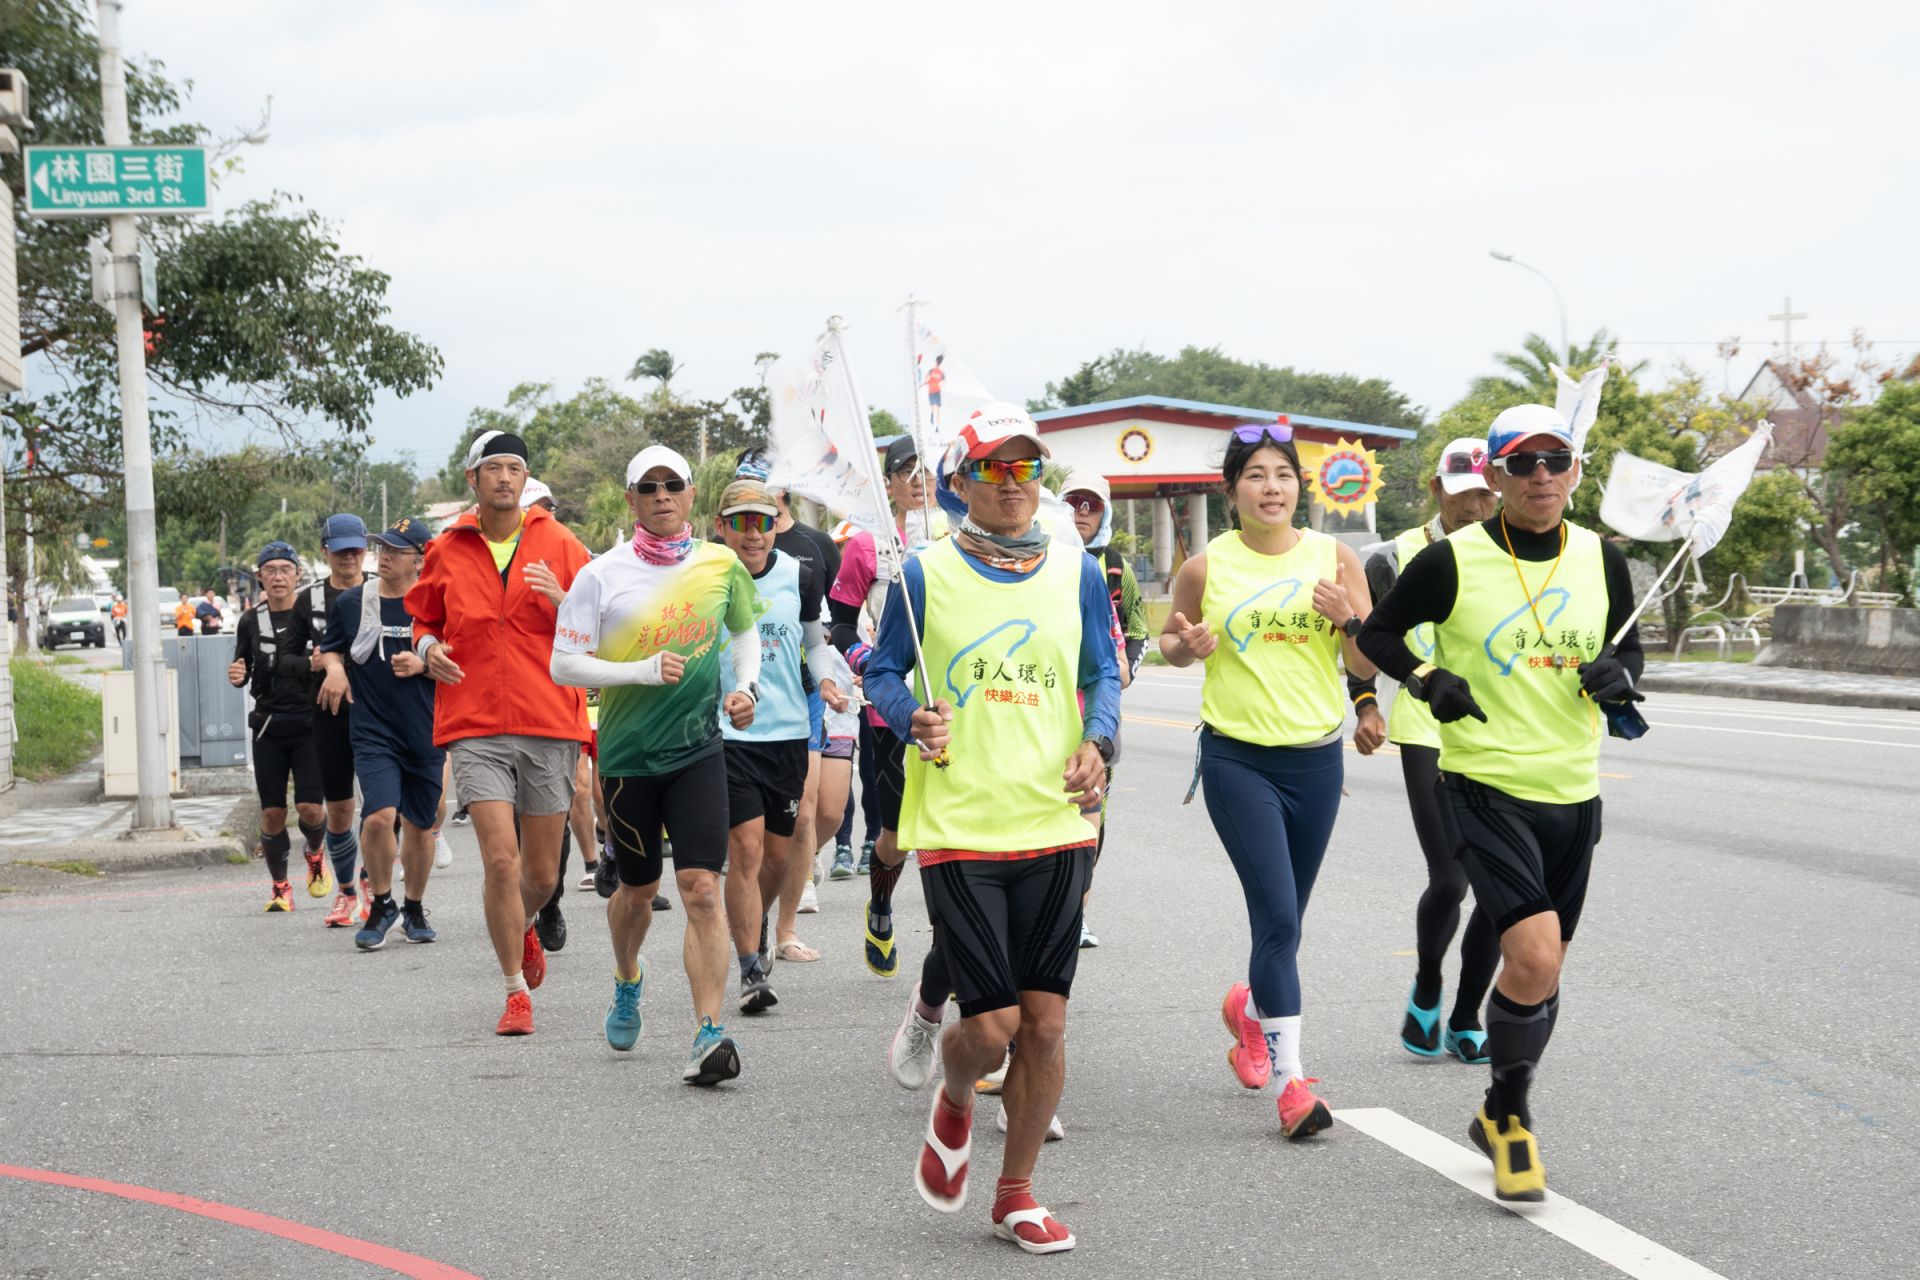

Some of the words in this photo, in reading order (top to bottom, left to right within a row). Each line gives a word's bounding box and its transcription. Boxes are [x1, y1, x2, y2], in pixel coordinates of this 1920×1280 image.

[51, 153, 184, 184] 林園三街
[51, 187, 120, 208] Linyuan
[126, 186, 155, 203] 3rd
[161, 186, 186, 203] St.
[662, 602, 698, 621] 政大
[654, 619, 708, 647] EMBA
[1263, 632, 1309, 644] 快樂公益
[1511, 628, 1596, 650] 盲人環台
[969, 658, 1056, 689] 盲人環台
[984, 688, 1039, 707] 快樂公益
